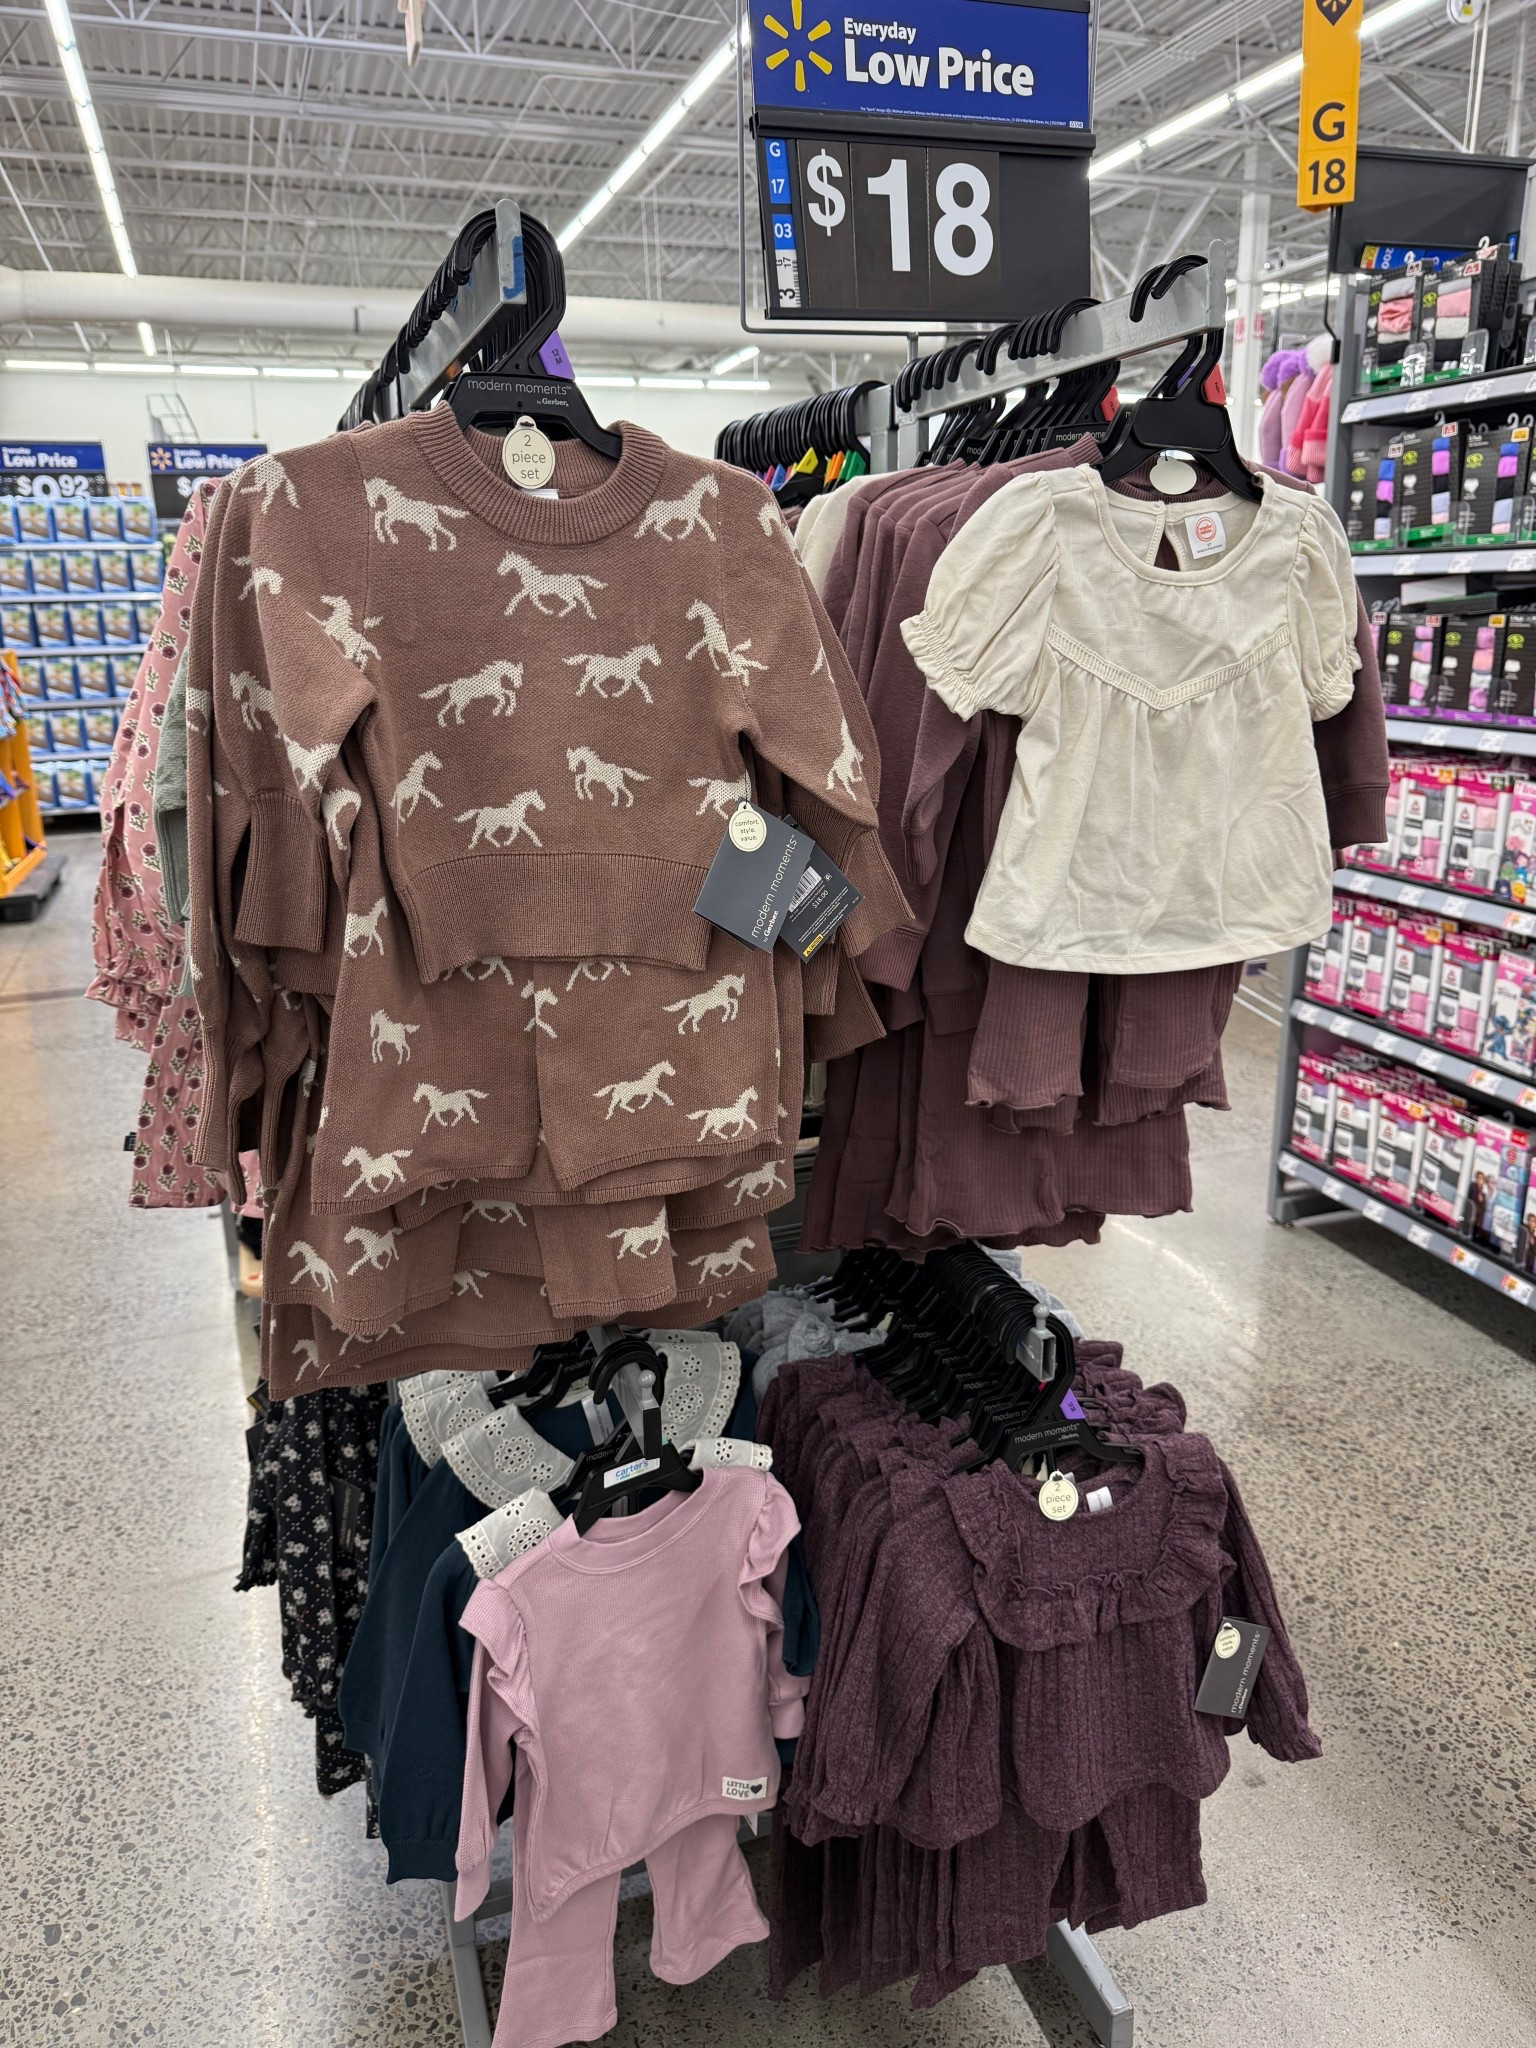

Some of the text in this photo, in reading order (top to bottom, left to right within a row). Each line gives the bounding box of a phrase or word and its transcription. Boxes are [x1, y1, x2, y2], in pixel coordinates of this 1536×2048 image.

[843, 17, 917, 44] Everyday
[844, 38, 1034, 96] Low Price
[1312, 101, 1346, 142] G
[769, 142, 781, 157] G
[1308, 158, 1346, 195] 18
[771, 178, 785, 194] 17
[774, 223, 793, 238] 03
[551, 349, 560, 357] 12
[555, 357, 563, 365] M
[467, 379, 513, 392] modern
[524, 435, 532, 447] 2
[3, 452, 78, 468] Low Price
[512, 451, 547, 465] piece
[520, 468, 540, 480] set
[751, 892, 775, 938] modern
[1014, 1430, 1044, 1443] modern
[615, 1460, 649, 1478] carter's
[1055, 1483, 1061, 1492] 2
[1046, 1494, 1072, 1505] piece
[1052, 1505, 1067, 1514] set
[1231, 1677, 1246, 1714] modern
[726, 1781, 750, 1790] LITTLE
[726, 1787, 750, 1798] LOVE
